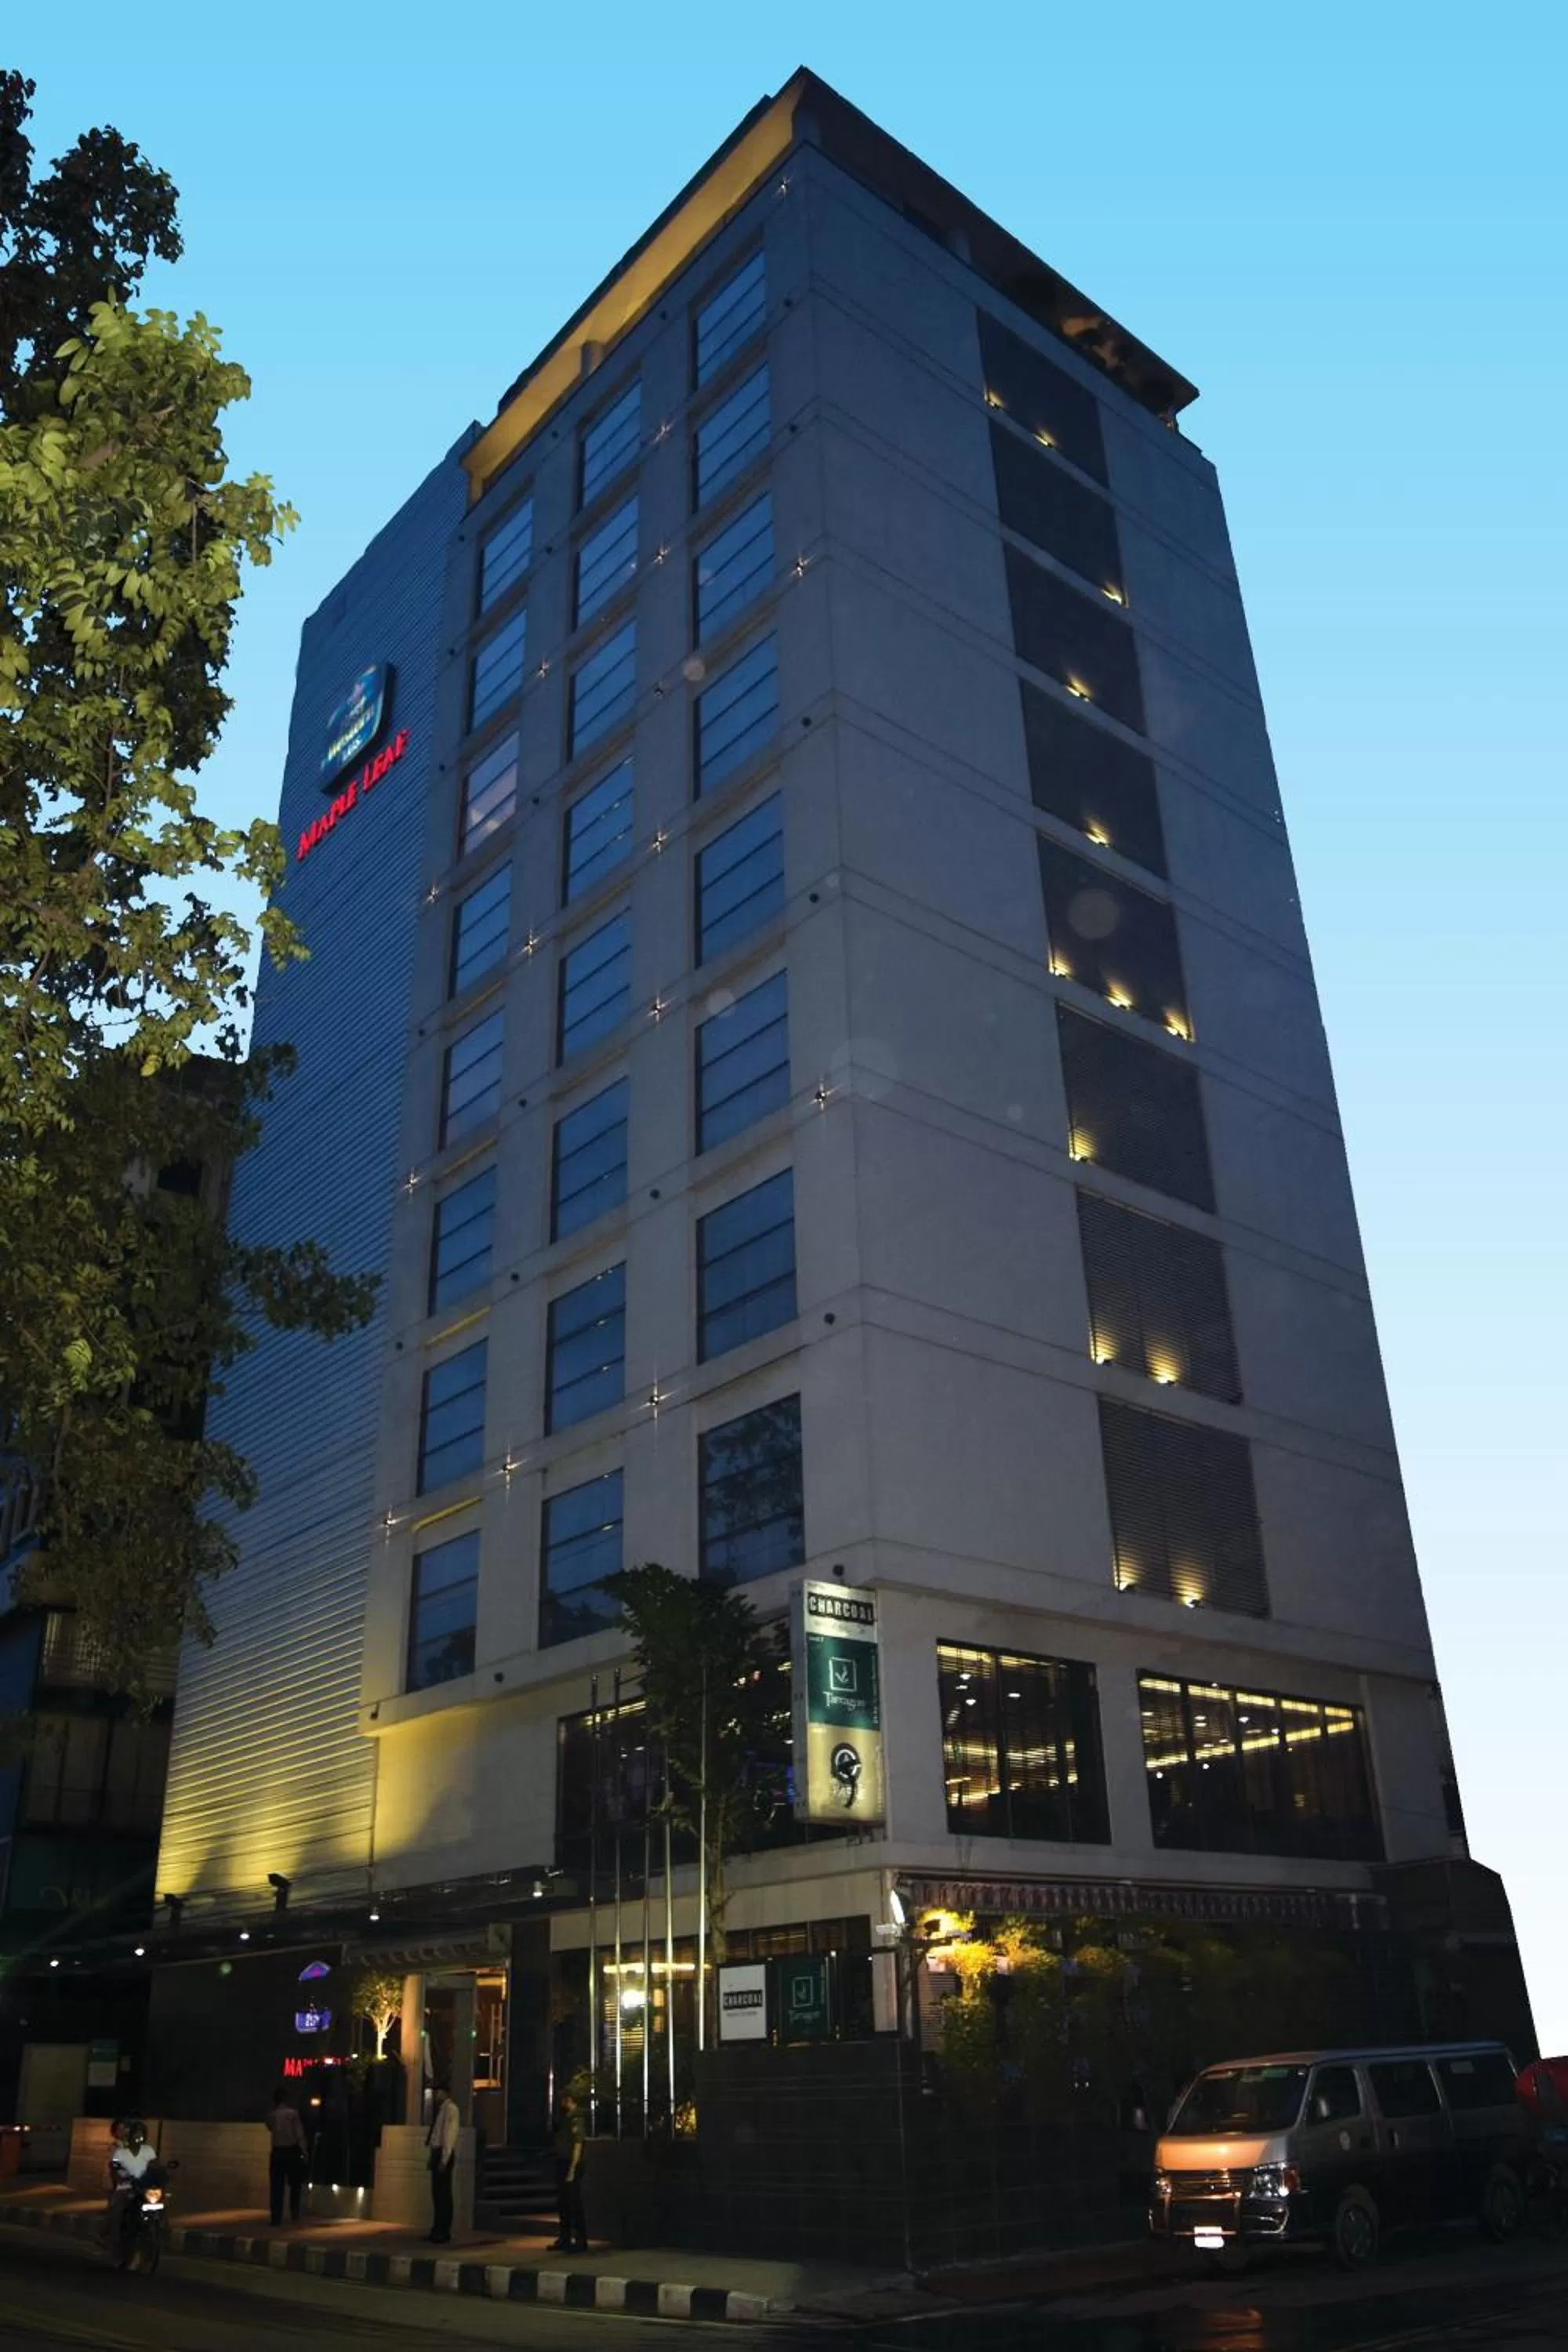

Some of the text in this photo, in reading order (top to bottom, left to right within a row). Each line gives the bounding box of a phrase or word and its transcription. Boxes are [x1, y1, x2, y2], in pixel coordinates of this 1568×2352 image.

[296, 781, 358, 862] MAPLE
[363, 728, 410, 793] LEAF
[808, 1595, 873, 1622] CHARCOAL
